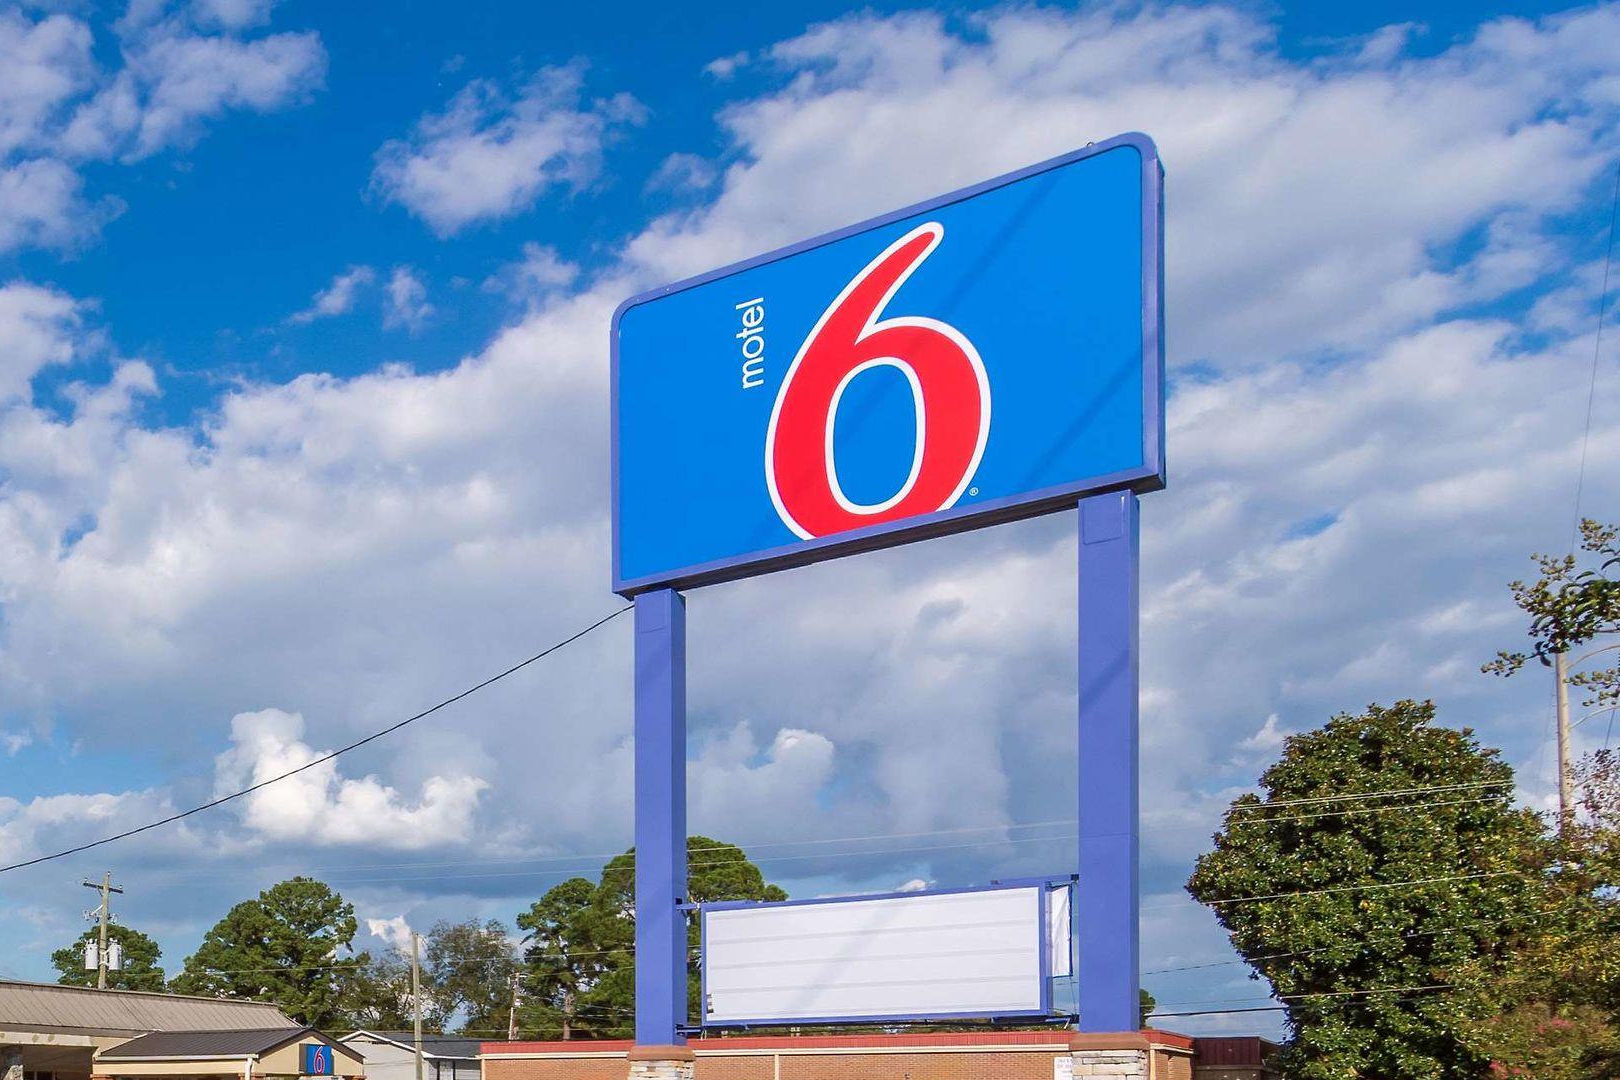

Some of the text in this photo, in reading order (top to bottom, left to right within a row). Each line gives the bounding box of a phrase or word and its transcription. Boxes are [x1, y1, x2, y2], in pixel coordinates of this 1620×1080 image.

[735, 221, 992, 540] motel 6
[314, 1046, 325, 1074] 6
